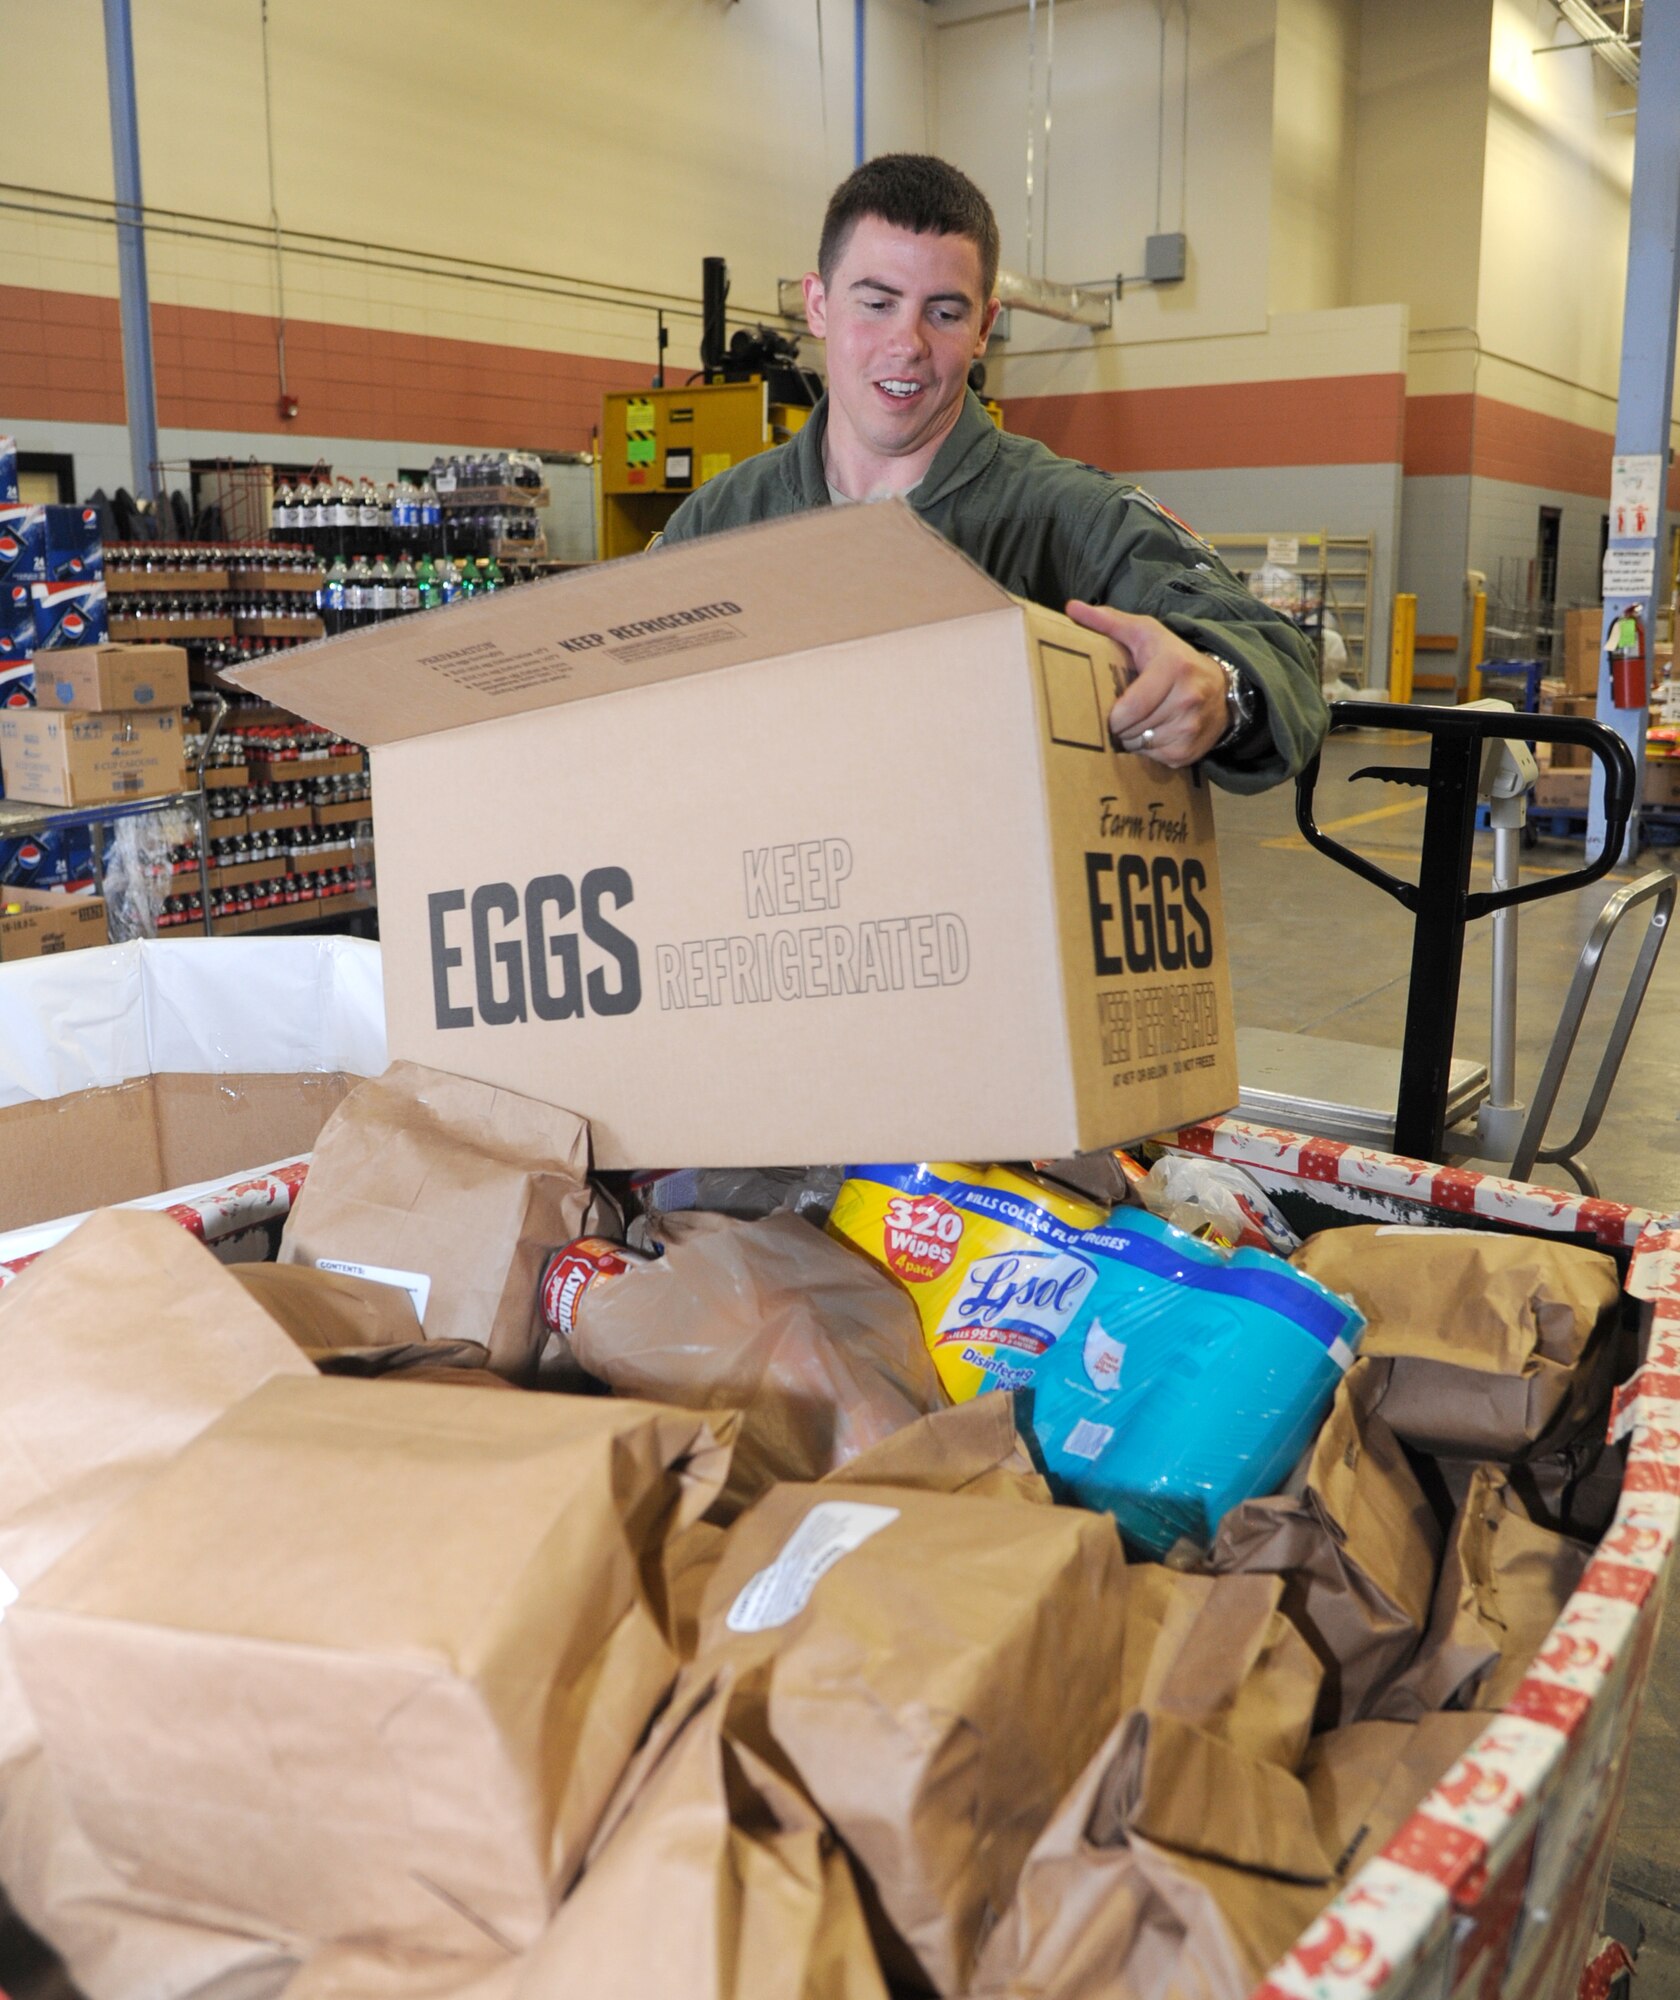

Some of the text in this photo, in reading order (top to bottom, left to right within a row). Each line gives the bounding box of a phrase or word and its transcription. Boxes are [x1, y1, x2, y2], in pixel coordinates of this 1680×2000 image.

[557, 632, 606, 653] KEEP
[607, 601, 743, 641] REFRIGERATED
[1099, 796, 1189, 844] Farm Fresh
[743, 838, 853, 919] KEEP
[1085, 852, 1213, 976] EGGS
[427, 866, 970, 1030] EGGS REFRIGERATED
[884, 1199, 963, 1244] 320
[1038, 1221, 1050, 1234] &
[320, 1261, 366, 1275] CONTENTS:
[889, 1229, 951, 1264] Wipes
[895, 1253, 935, 1278] 4 pack
[958, 1257, 1087, 1322] Lysol
[970, 1328, 1006, 1342] 99.9%
